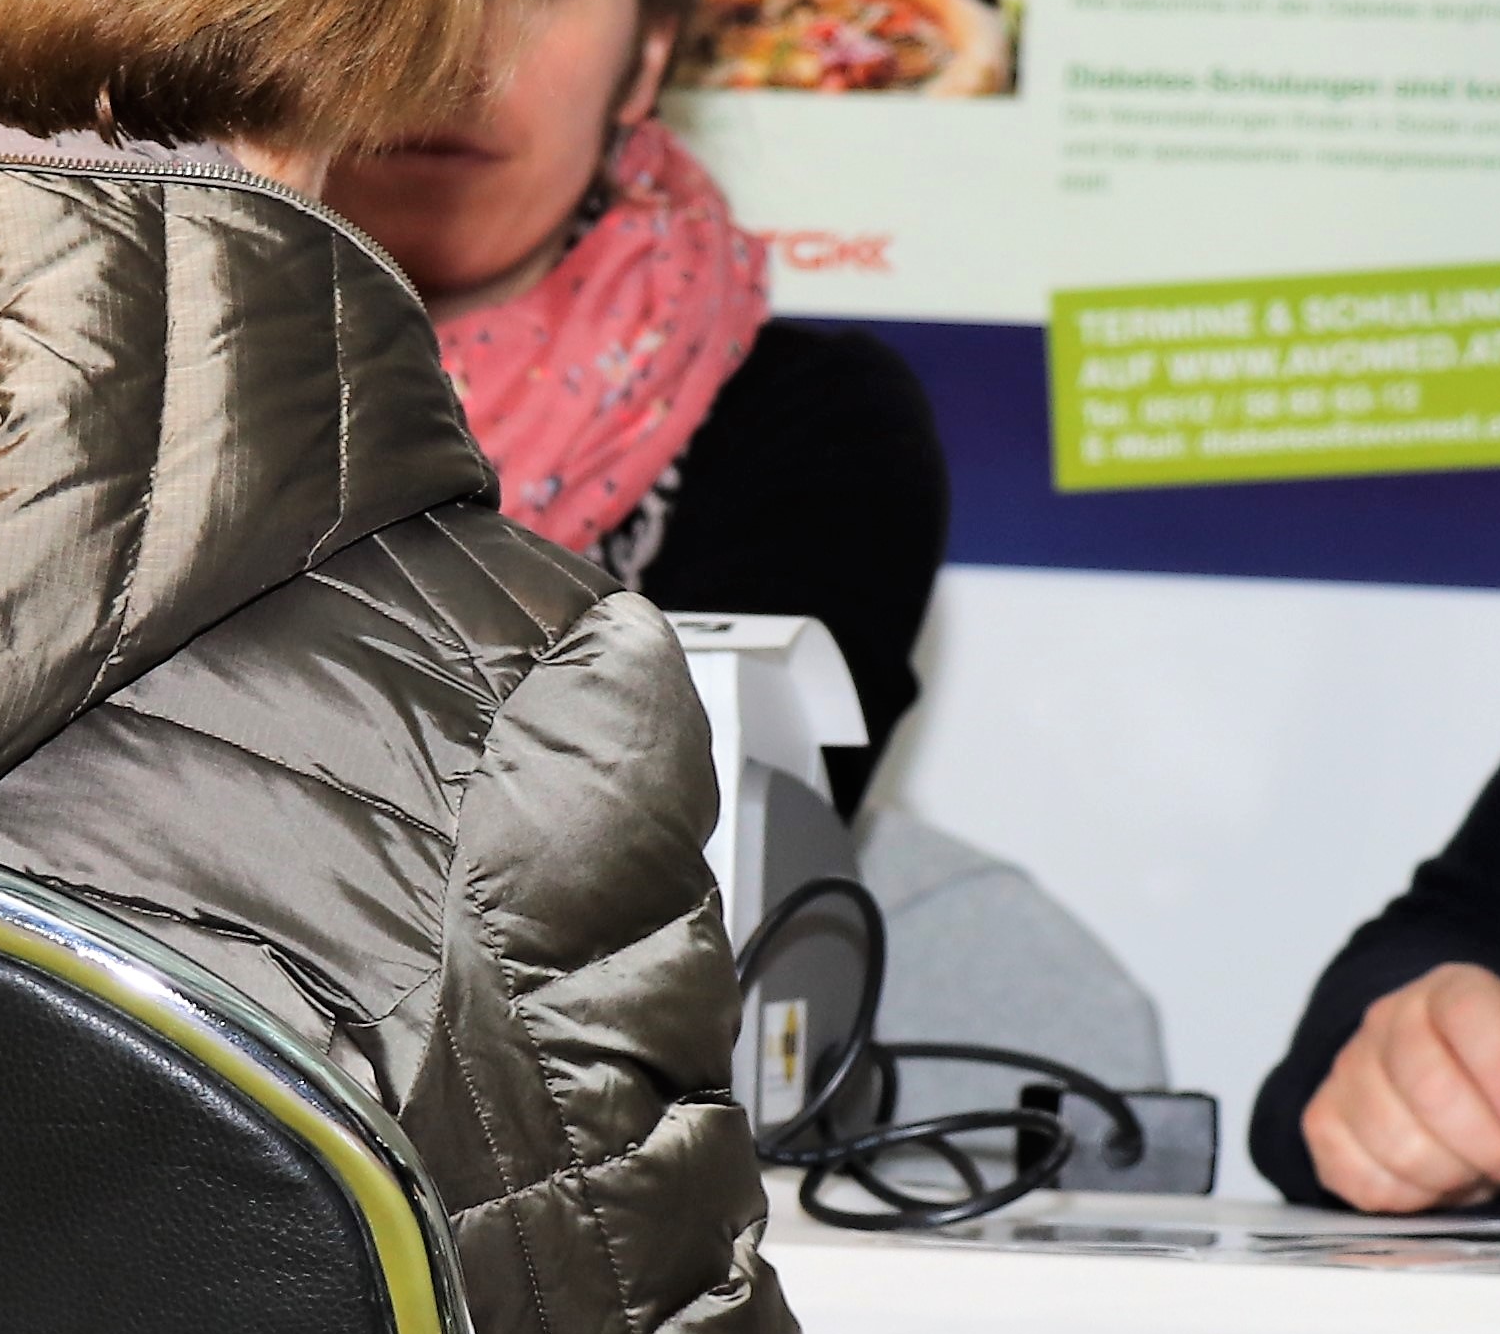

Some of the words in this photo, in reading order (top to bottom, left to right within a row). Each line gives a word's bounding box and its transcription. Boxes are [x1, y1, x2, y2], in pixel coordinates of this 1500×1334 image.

[1080, 300, 1254, 347] TERMINE
[1265, 297, 1292, 335] &
[1078, 349, 1158, 389] AUF
